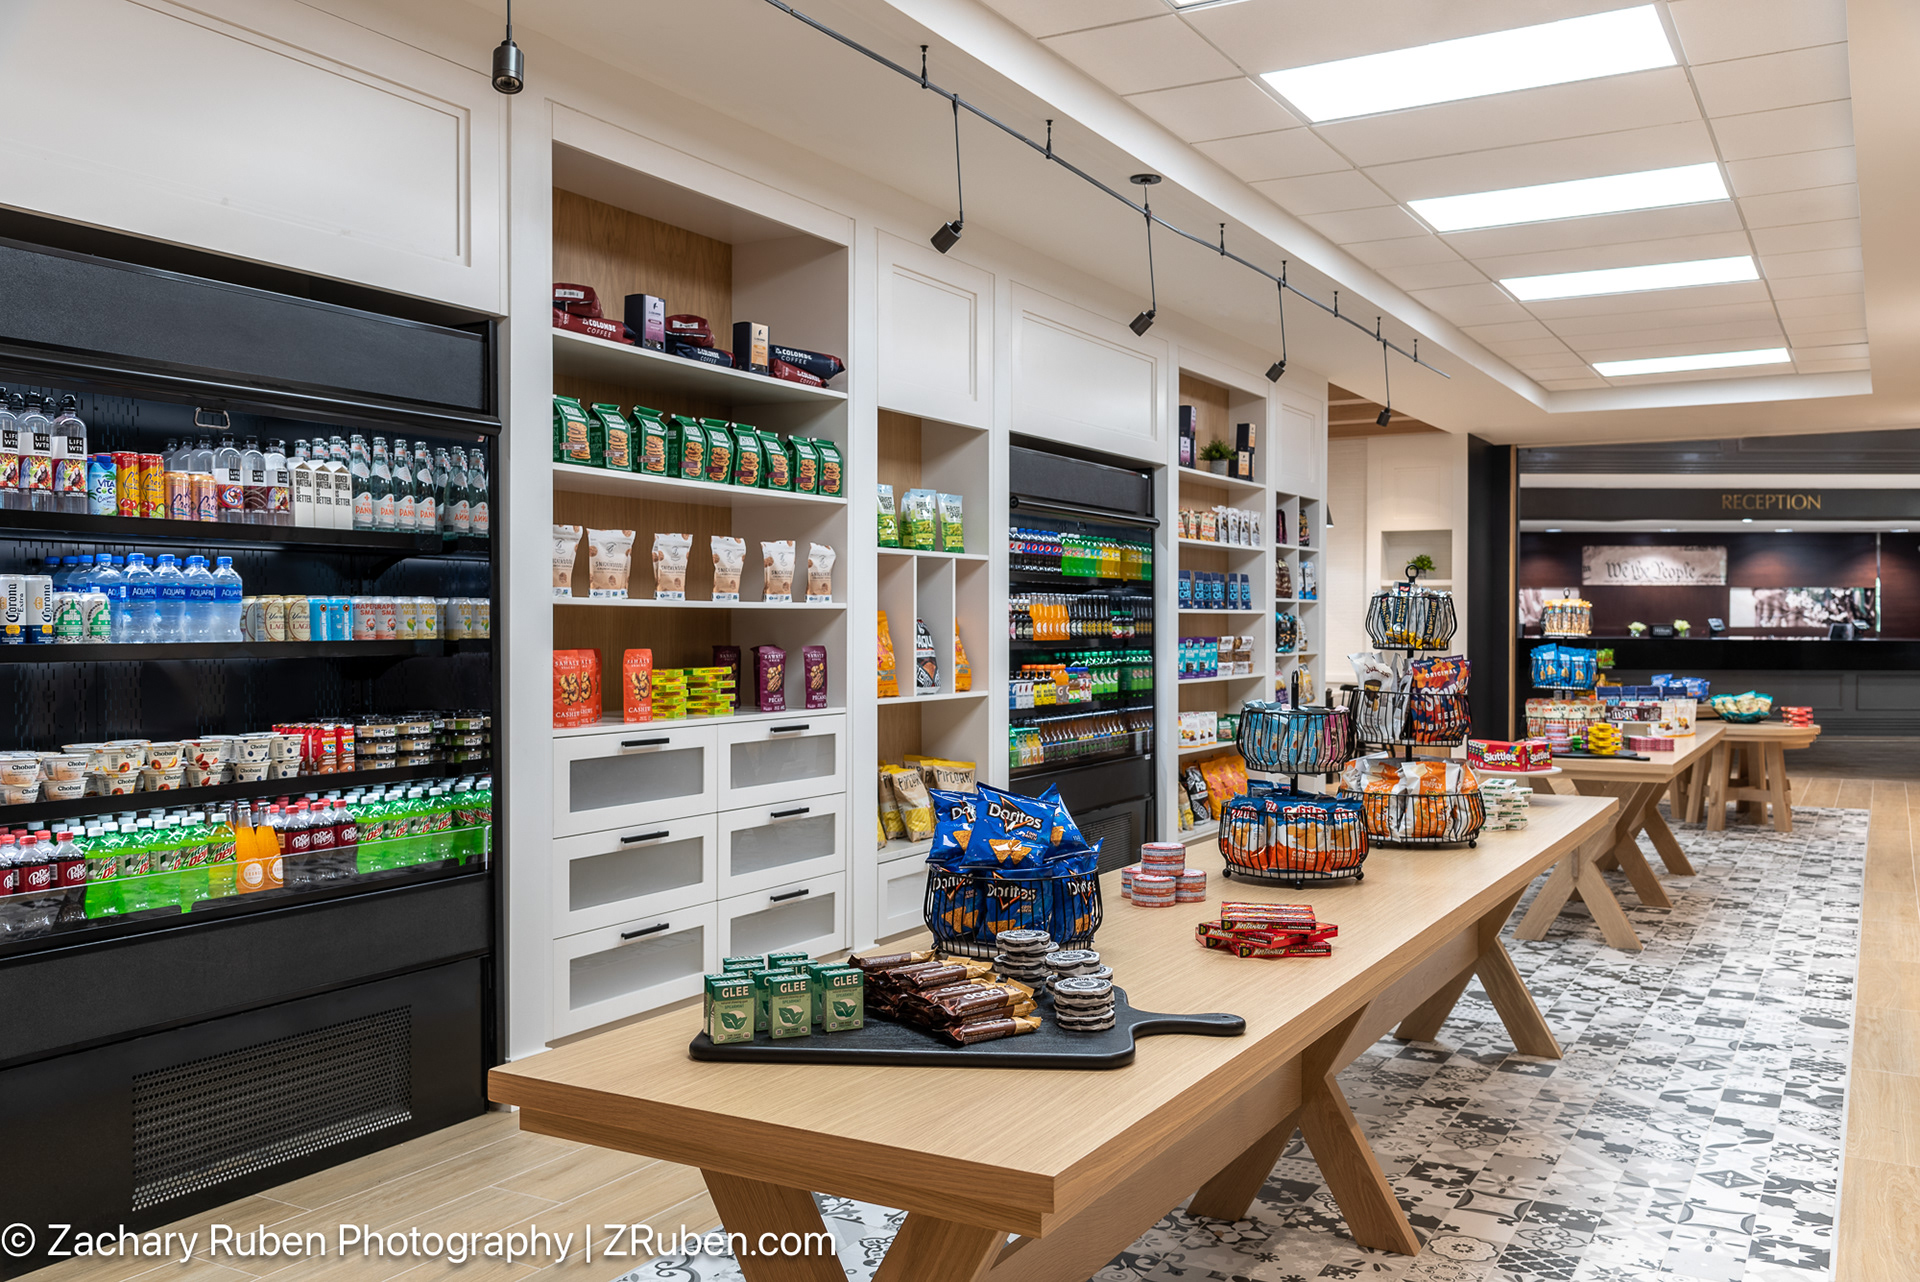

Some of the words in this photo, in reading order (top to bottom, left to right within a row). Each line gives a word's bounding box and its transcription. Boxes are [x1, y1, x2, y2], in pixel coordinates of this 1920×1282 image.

[587, 326, 612, 338] COFFEE
[781, 356, 807, 365] COFFEE
[335, 474, 347, 482] BOXED
[1722, 494, 1821, 510] RECEPTION
[1606, 560, 1628, 578] We
[1652, 561, 1696, 582] People
[6, 583, 19, 622] Corona
[42, 584, 52, 622] Corona
[1425, 669, 1457, 678] ORIGINAL
[1483, 752, 1516, 762] Skittles
[1530, 752, 1550, 763] Skittles
[936, 770, 972, 783] PIPCORN
[988, 803, 1042, 829] Doritos
[987, 883, 1036, 900] Doritos
[834, 974, 858, 987] GLEE
[722, 986, 749, 998] GLEE
[780, 981, 806, 993] GLEE
[963, 988, 1004, 1000] dang
